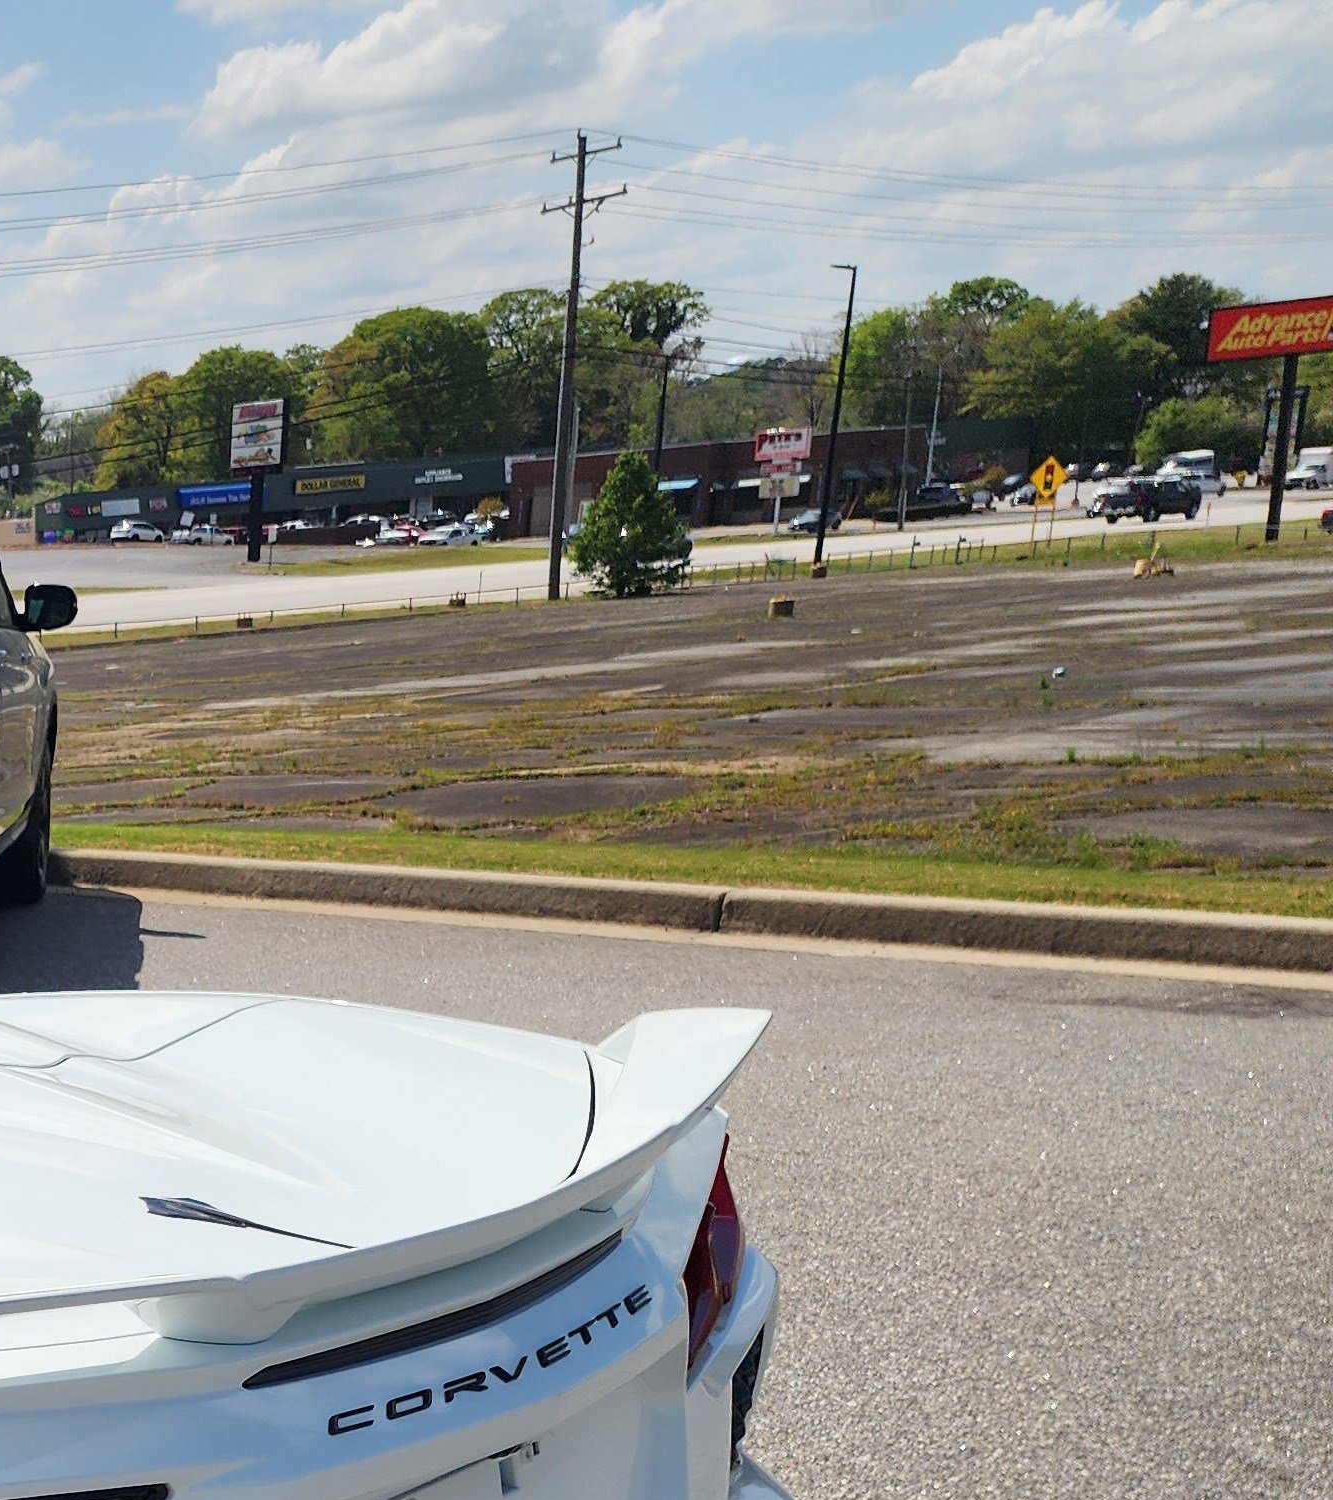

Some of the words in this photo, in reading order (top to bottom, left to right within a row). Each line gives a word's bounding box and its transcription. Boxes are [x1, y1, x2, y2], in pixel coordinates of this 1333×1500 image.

[1229, 310, 1329, 336] Advance
[1216, 333, 1269, 352] Auto
[301, 480, 327, 491] DOLLAR
[327, 1284, 653, 1436] CORVETTE
